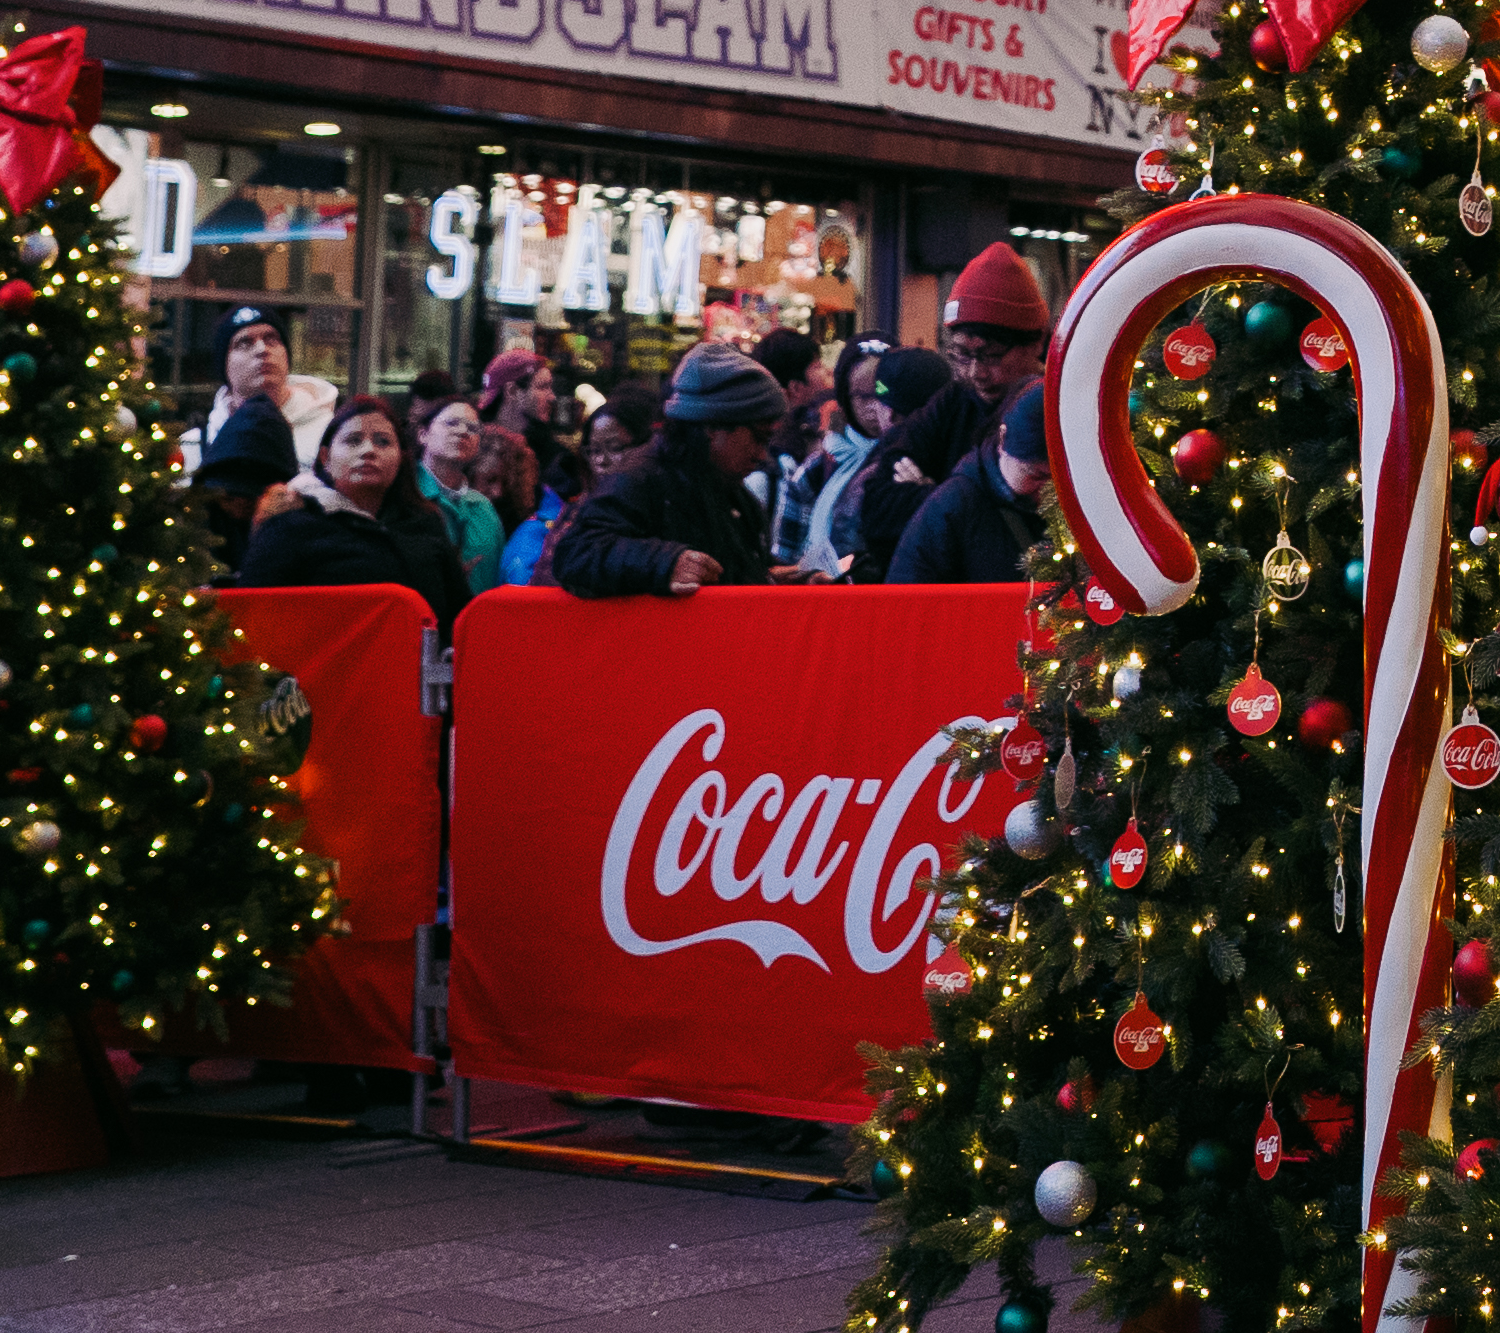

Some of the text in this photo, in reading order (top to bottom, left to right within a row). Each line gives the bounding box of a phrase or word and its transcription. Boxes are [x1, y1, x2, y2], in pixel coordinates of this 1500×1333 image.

[914, 5, 1025, 58] GIFTS &
[887, 49, 1057, 111] SOUVENIRS
[427, 189, 701, 317] SLAM
